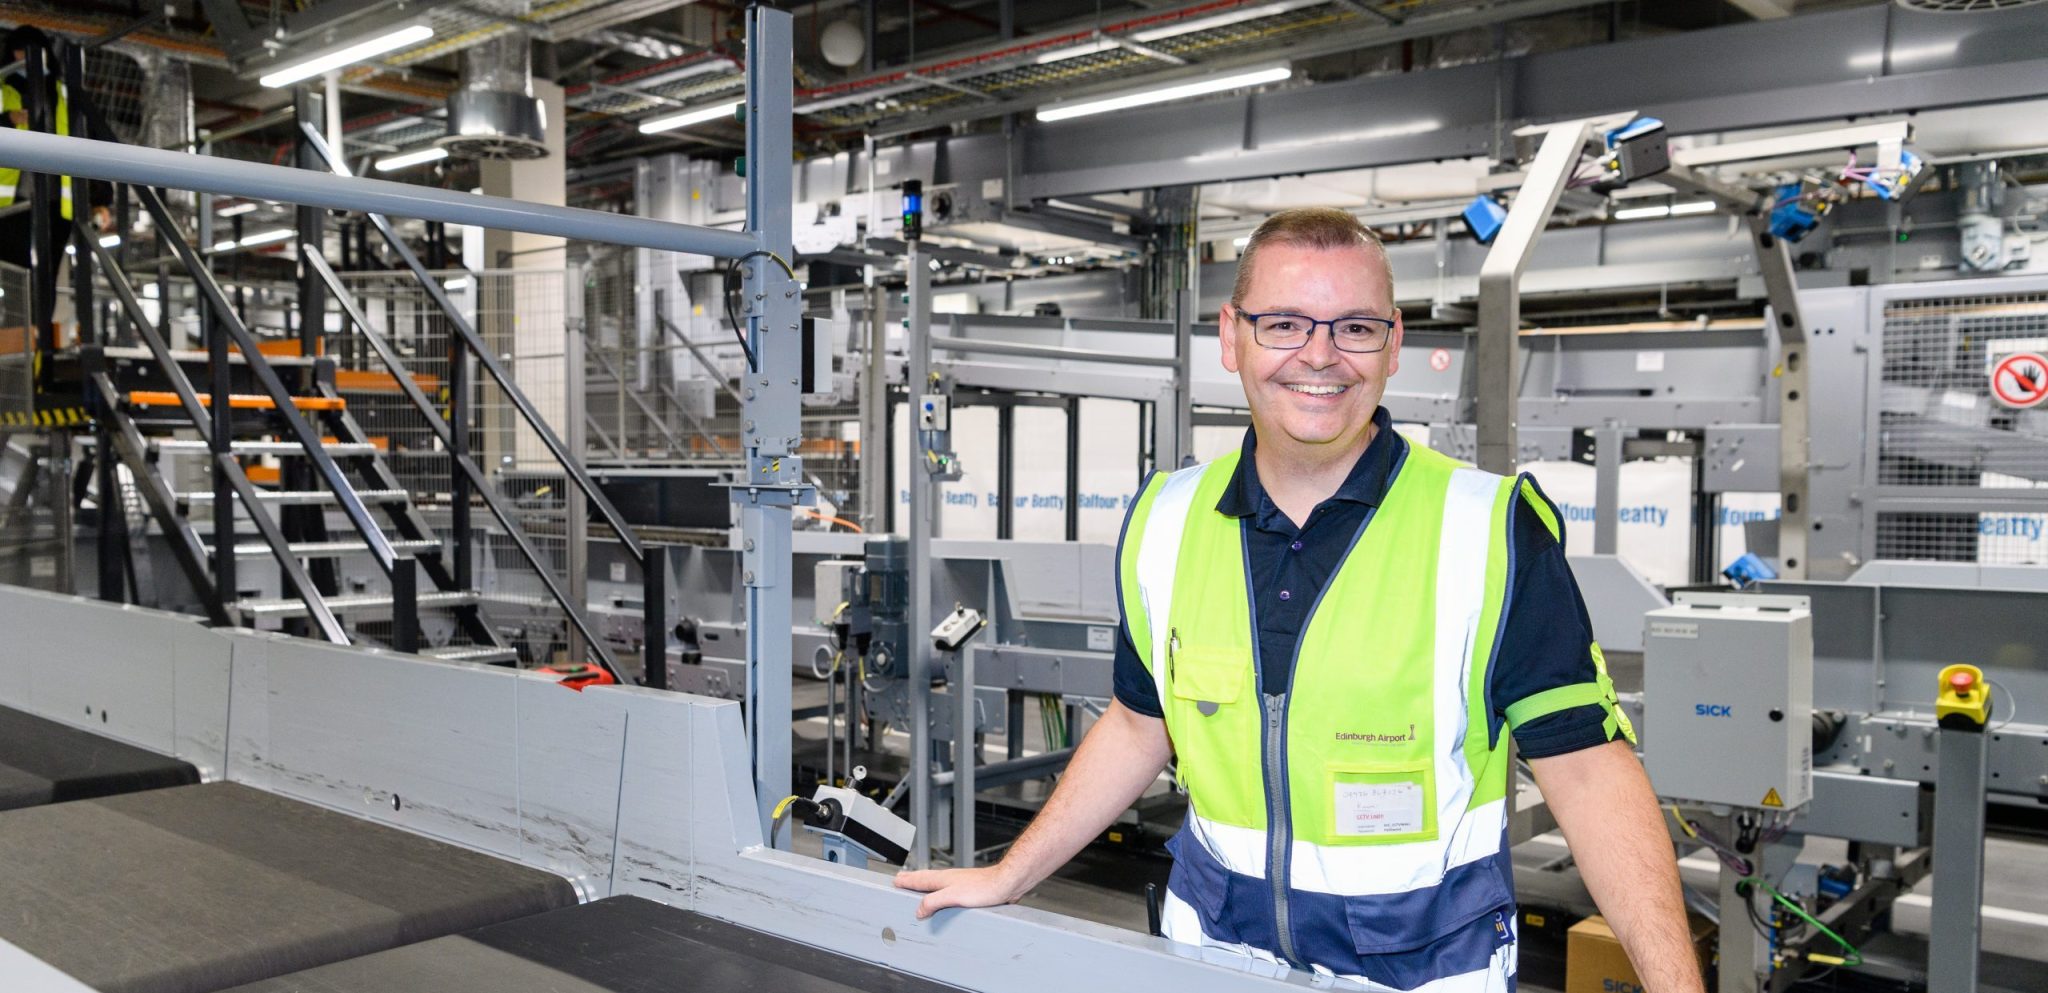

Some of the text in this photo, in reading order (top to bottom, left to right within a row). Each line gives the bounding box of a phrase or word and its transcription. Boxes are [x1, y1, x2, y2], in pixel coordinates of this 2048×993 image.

[1619, 506, 1668, 527] eatty
[1978, 517, 2044, 541] eatty
[1695, 704, 1732, 718] SICK
[1335, 732, 1406, 743] Edinburgh Airport
